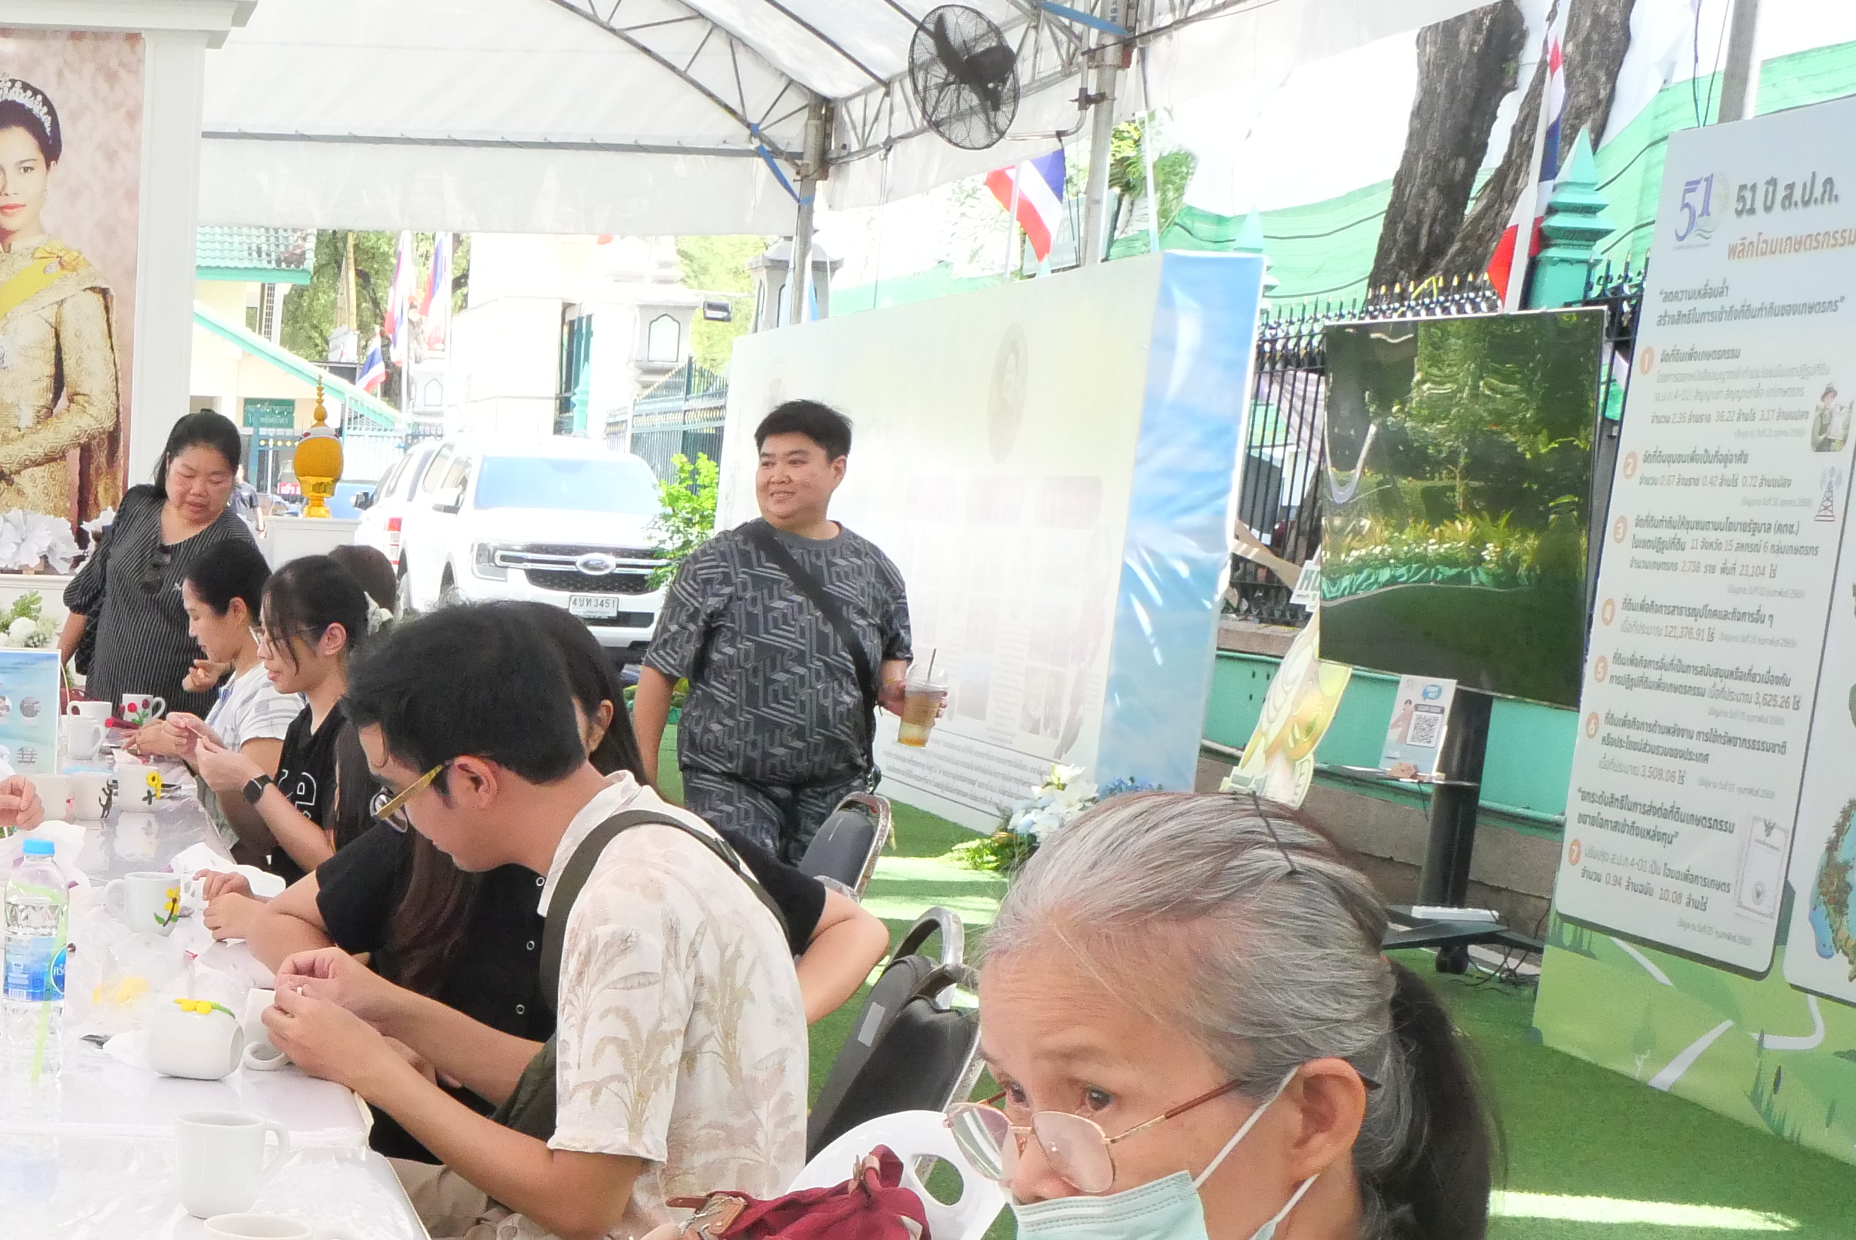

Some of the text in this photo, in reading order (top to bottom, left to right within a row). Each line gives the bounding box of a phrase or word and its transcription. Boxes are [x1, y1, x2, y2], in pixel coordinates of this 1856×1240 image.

[1674, 173, 1715, 242] 51
[1734, 171, 1839, 219] 51 ปี ส.ป.ก.
[594, 598, 615, 608] 3451
